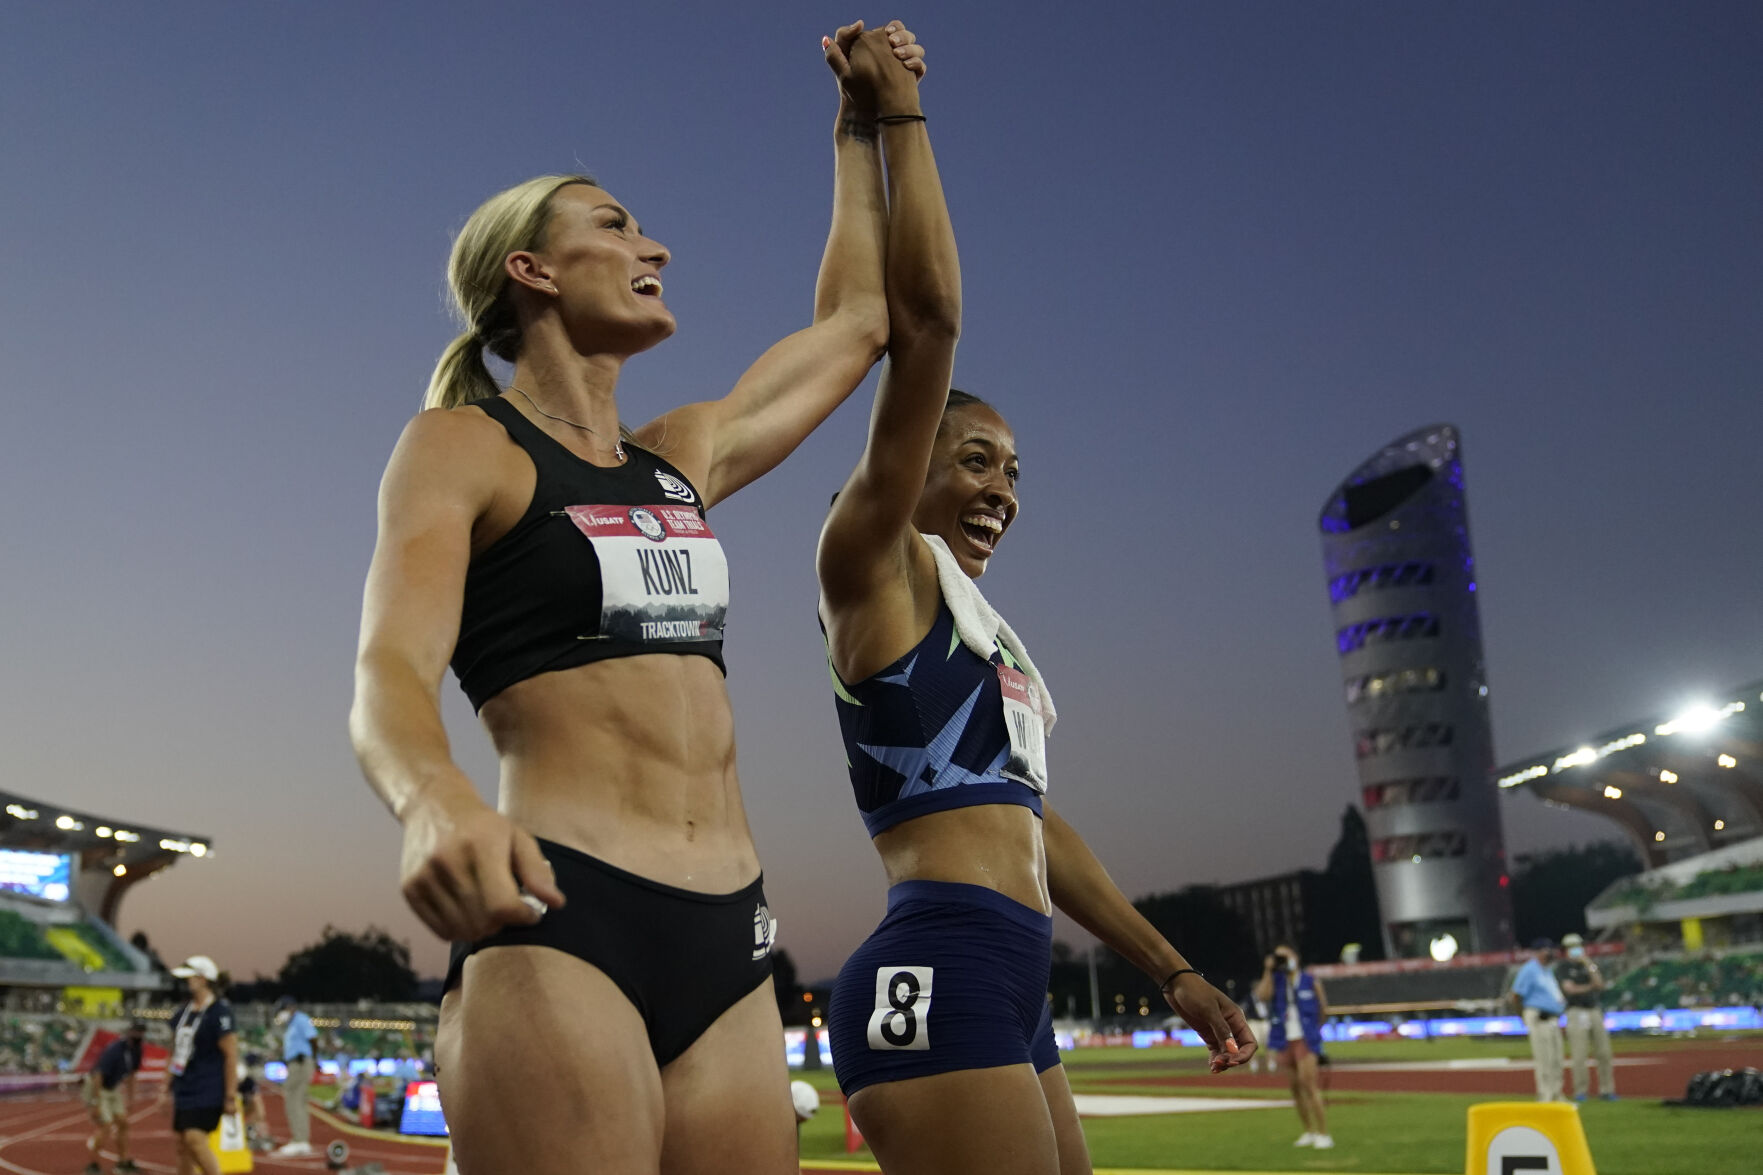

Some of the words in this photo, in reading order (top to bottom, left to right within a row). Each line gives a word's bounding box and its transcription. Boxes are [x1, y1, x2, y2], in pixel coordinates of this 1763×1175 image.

[595, 517, 624, 525] USATF
[636, 548, 698, 596] KUNZ
[640, 620, 700, 640] TRACKTOWN
[880, 971, 921, 1047] 8
